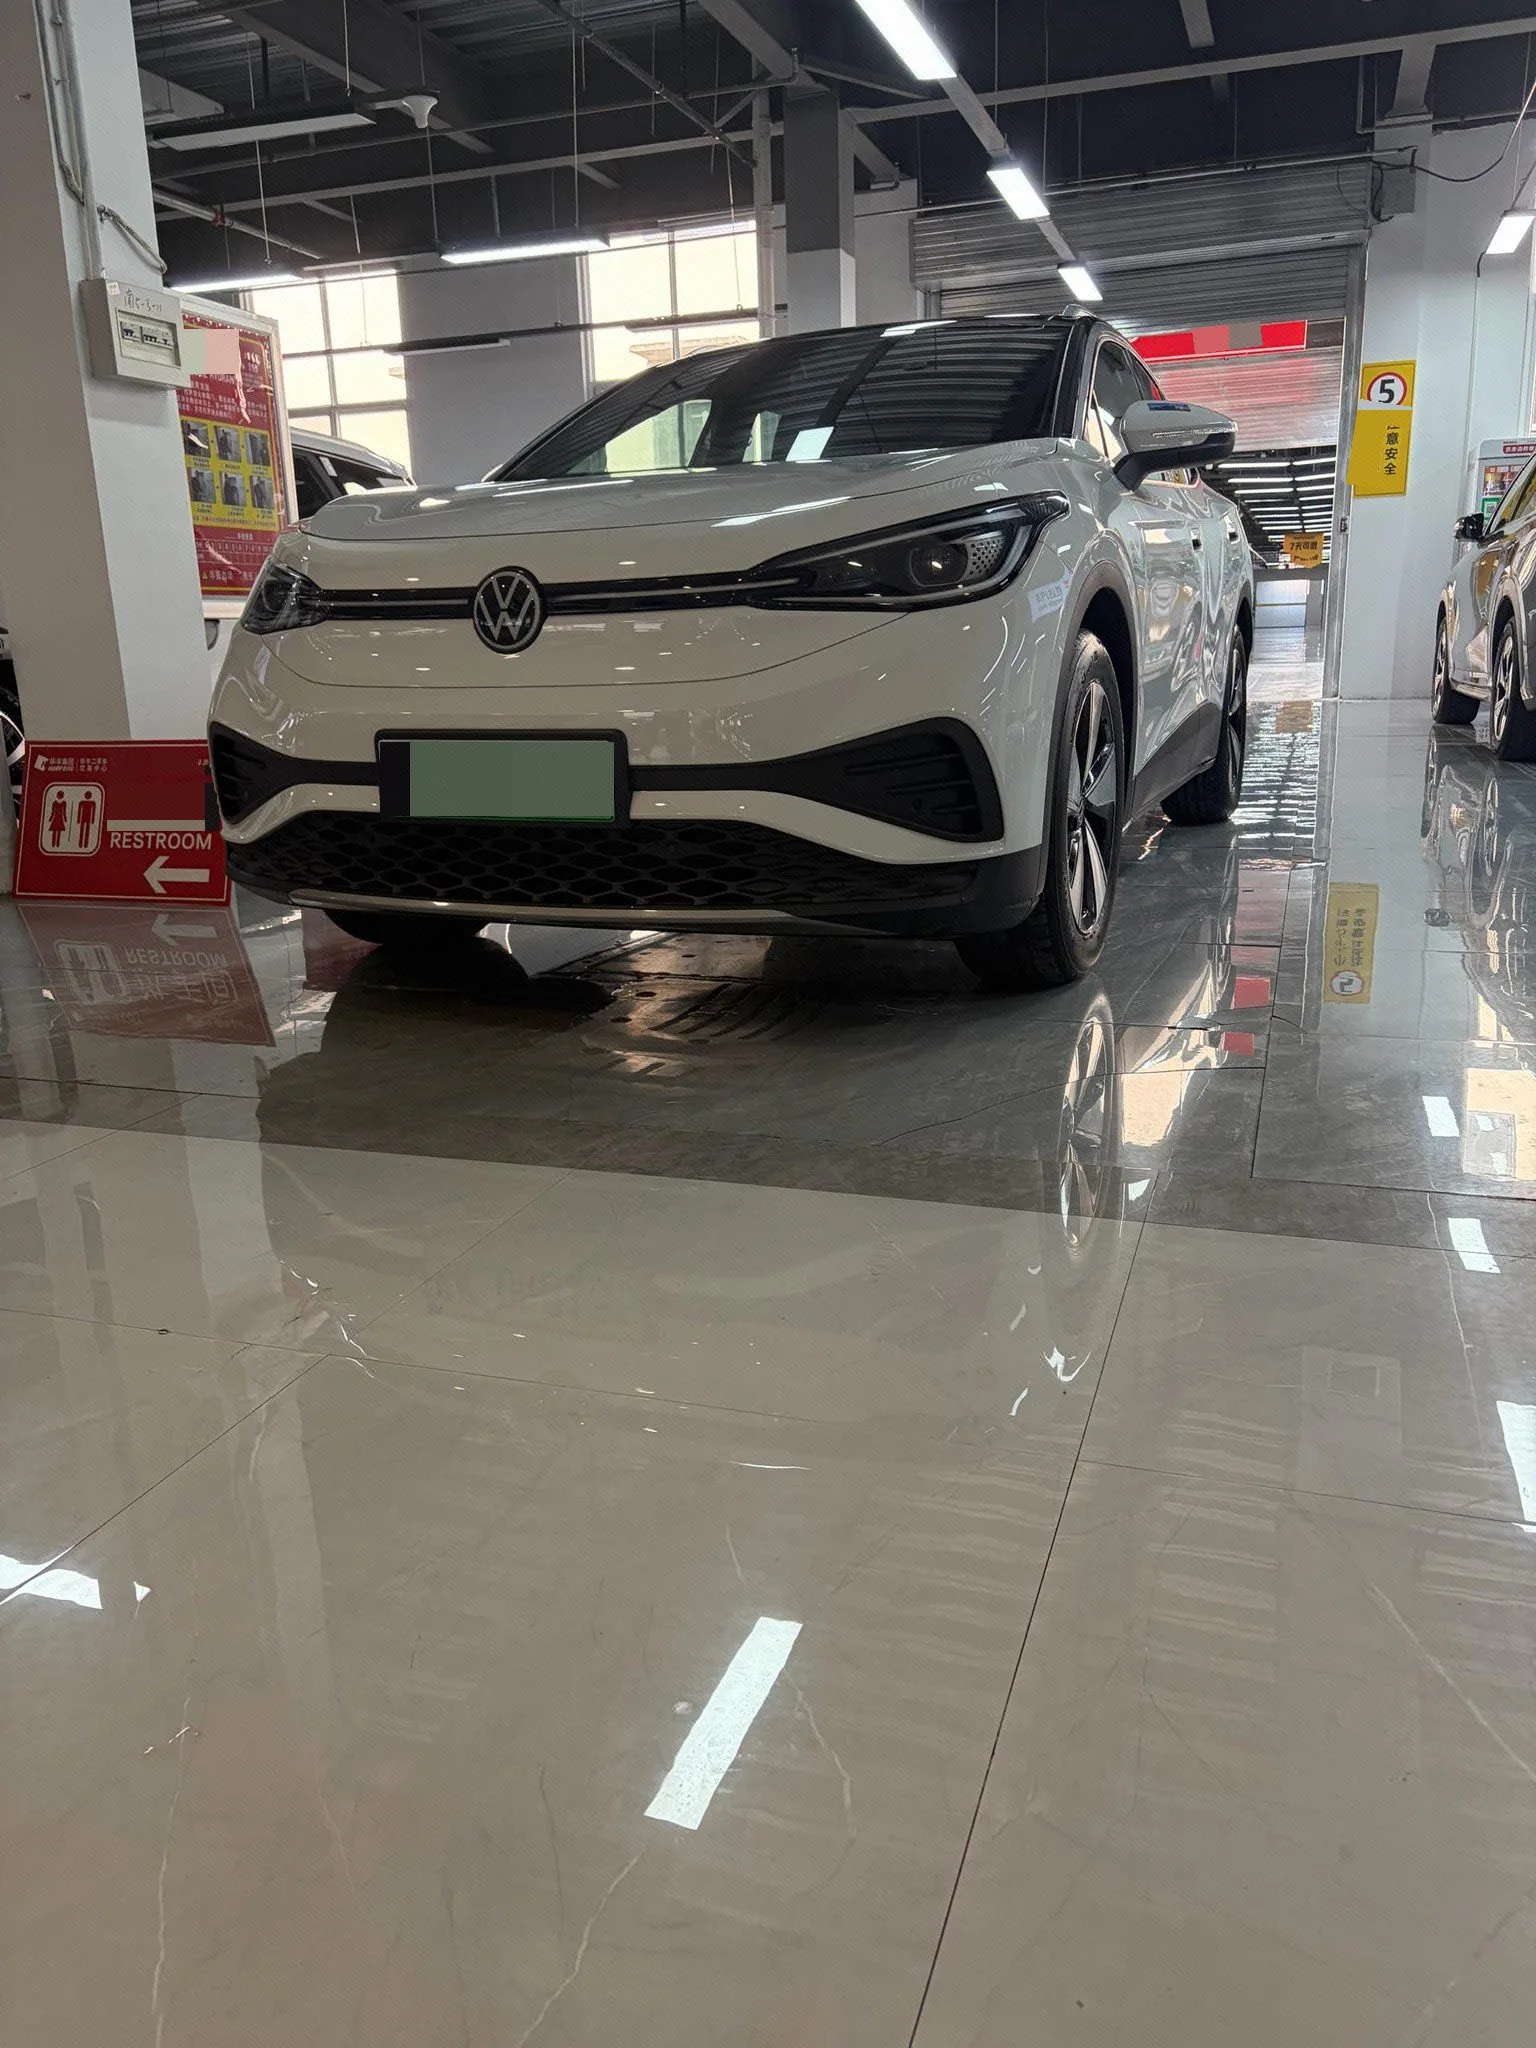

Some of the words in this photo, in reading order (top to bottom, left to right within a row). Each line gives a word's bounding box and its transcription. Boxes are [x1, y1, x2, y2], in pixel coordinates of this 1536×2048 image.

[1379, 379, 1395, 403] 5
[475, 570, 540, 650] VW
[110, 832, 213, 850] RESTROOM
